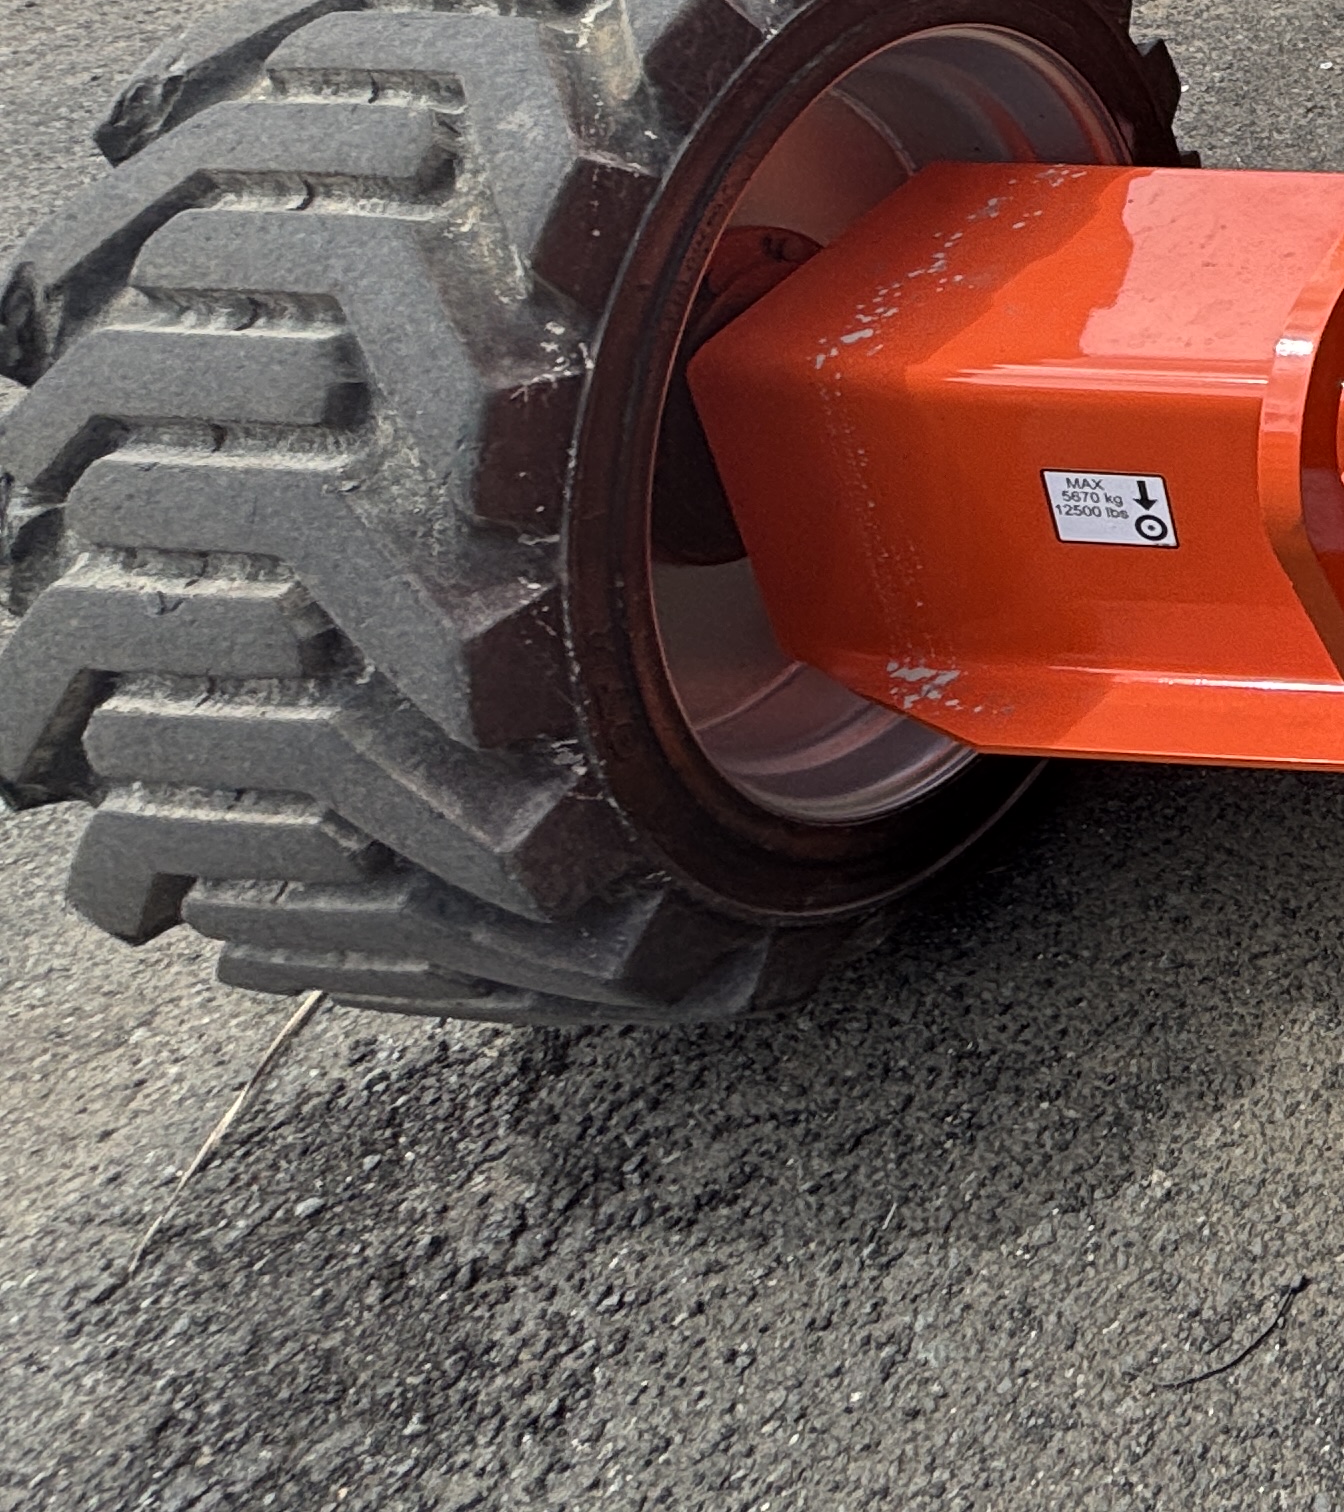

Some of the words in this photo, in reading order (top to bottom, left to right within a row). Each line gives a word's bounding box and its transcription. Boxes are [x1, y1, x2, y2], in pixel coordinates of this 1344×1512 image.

[1065, 477, 1105, 490] MAX
[1104, 493, 1123, 507] kg
[1055, 504, 1102, 517] 12500
[1105, 506, 1129, 519] lbs
